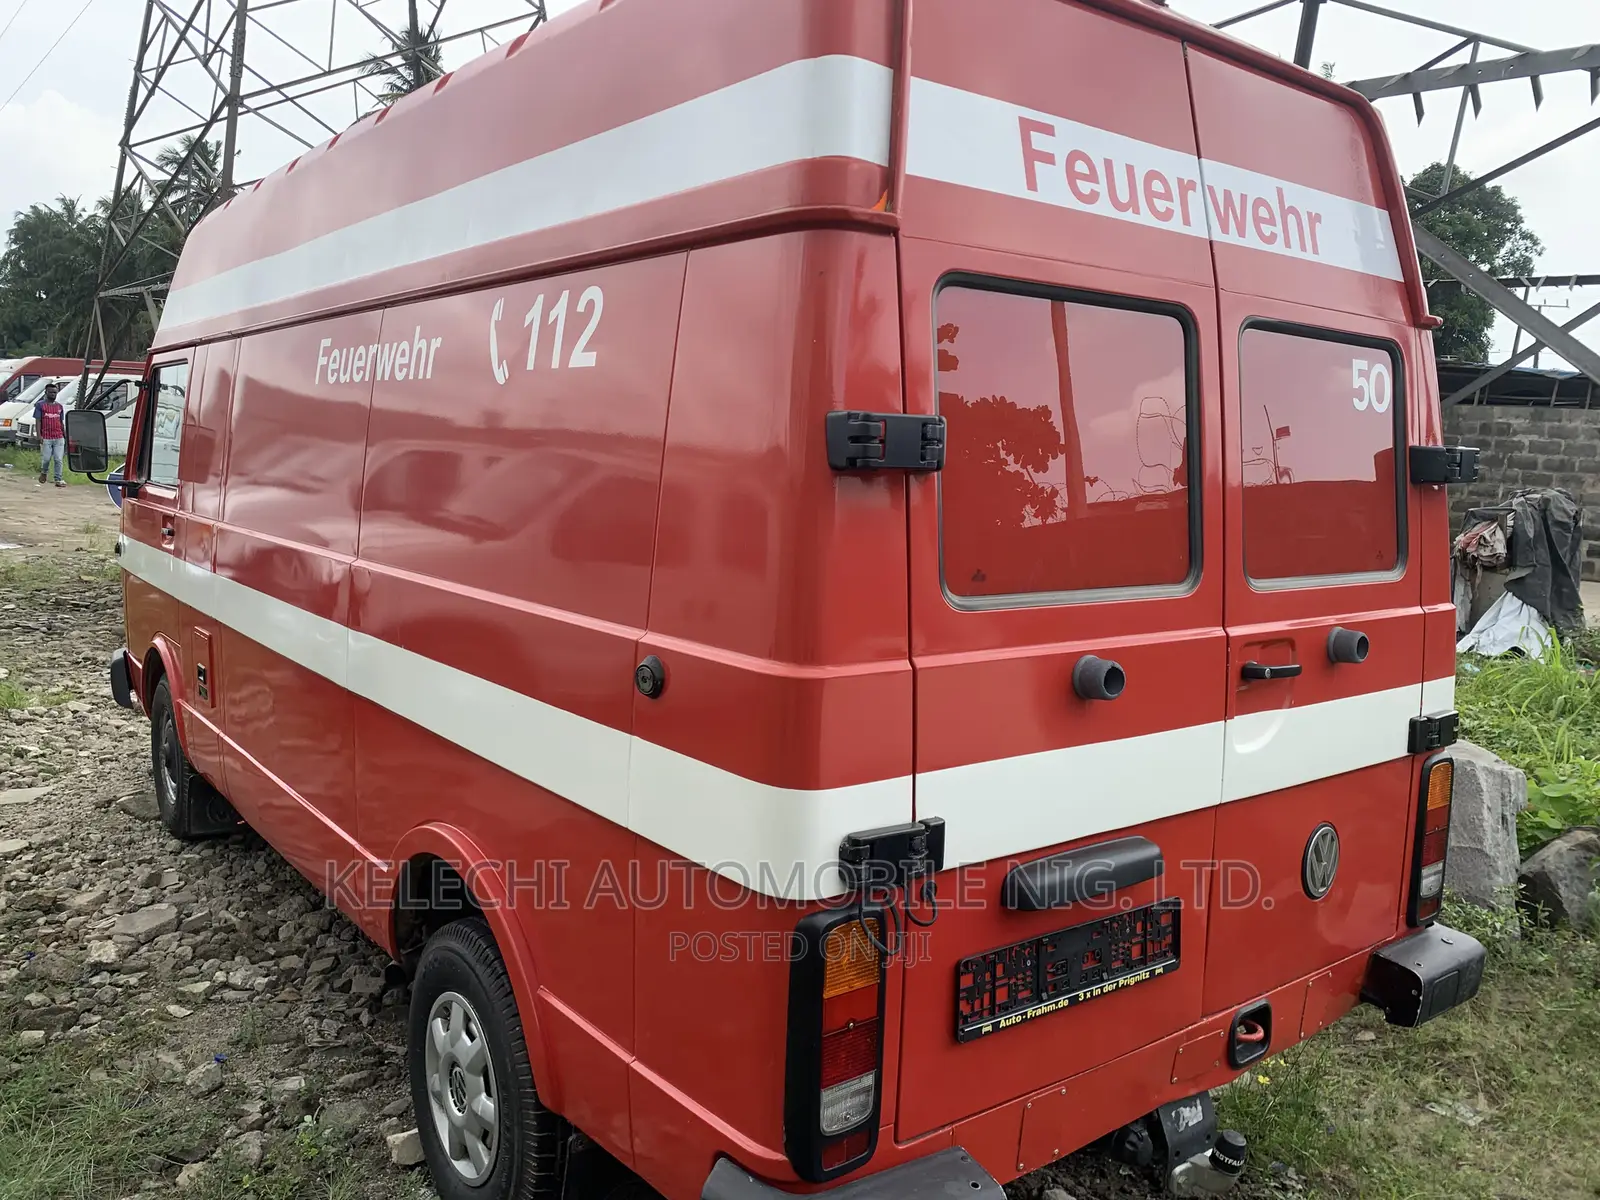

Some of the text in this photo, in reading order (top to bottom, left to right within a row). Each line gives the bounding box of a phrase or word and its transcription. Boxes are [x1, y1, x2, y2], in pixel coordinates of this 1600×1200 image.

[1017, 115, 1322, 256] Feuerwehr
[315, 286, 604, 385] Feuerwehr 112
[1352, 358, 1391, 413] 50
[1078, 991, 1085, 1001] 3
[1086, 991, 1091, 999] x
[1092, 986, 1101, 997] in
[1102, 983, 1118, 993] der
[1118, 971, 1150, 988] Prignitz
